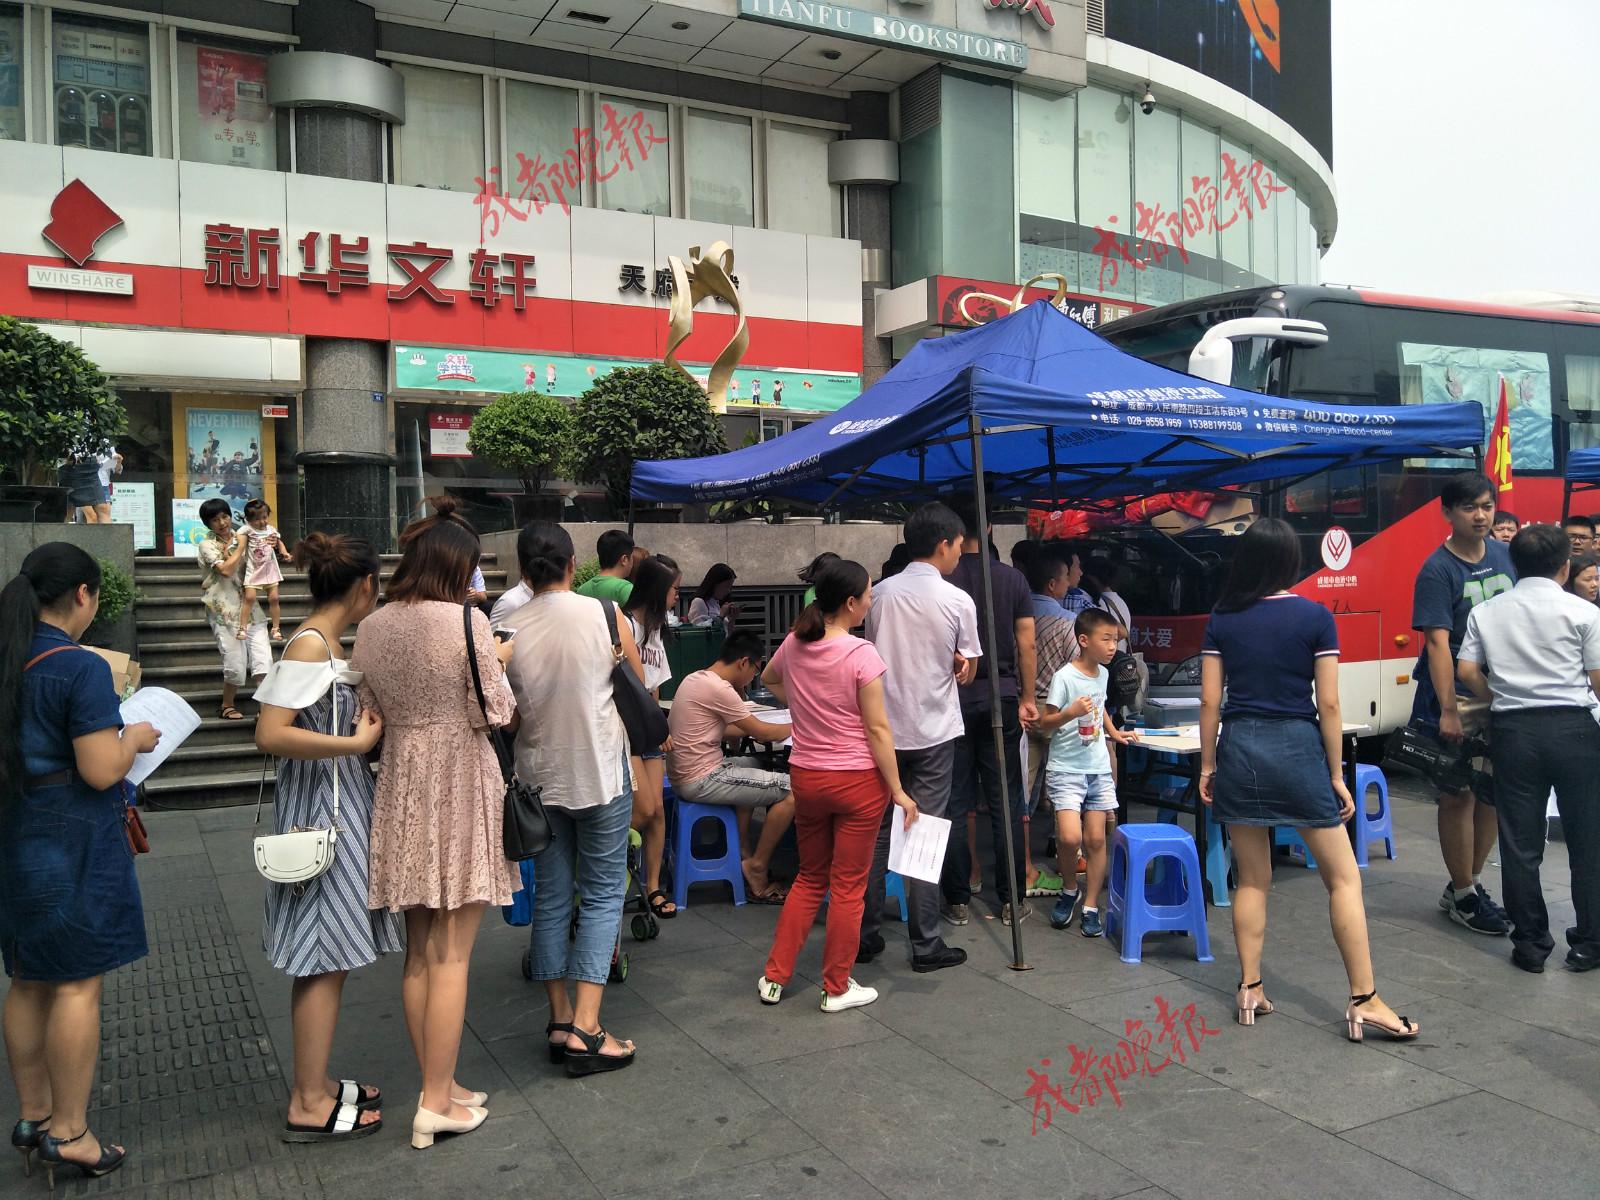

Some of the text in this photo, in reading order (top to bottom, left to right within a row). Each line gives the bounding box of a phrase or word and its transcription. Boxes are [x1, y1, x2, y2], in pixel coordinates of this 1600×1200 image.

[752, 0, 852, 30] TIANFU
[873, 16, 1024, 65] BOOKSTORE
[203, 223, 537, 311] 新华文轩
[36, 270, 126, 289] WINSHARE
[446, 355, 466, 365] 文轩
[438, 363, 473, 374] 学生节
[189, 412, 229, 428] NEVER
[1188, 419, 1243, 432] 15388199508
